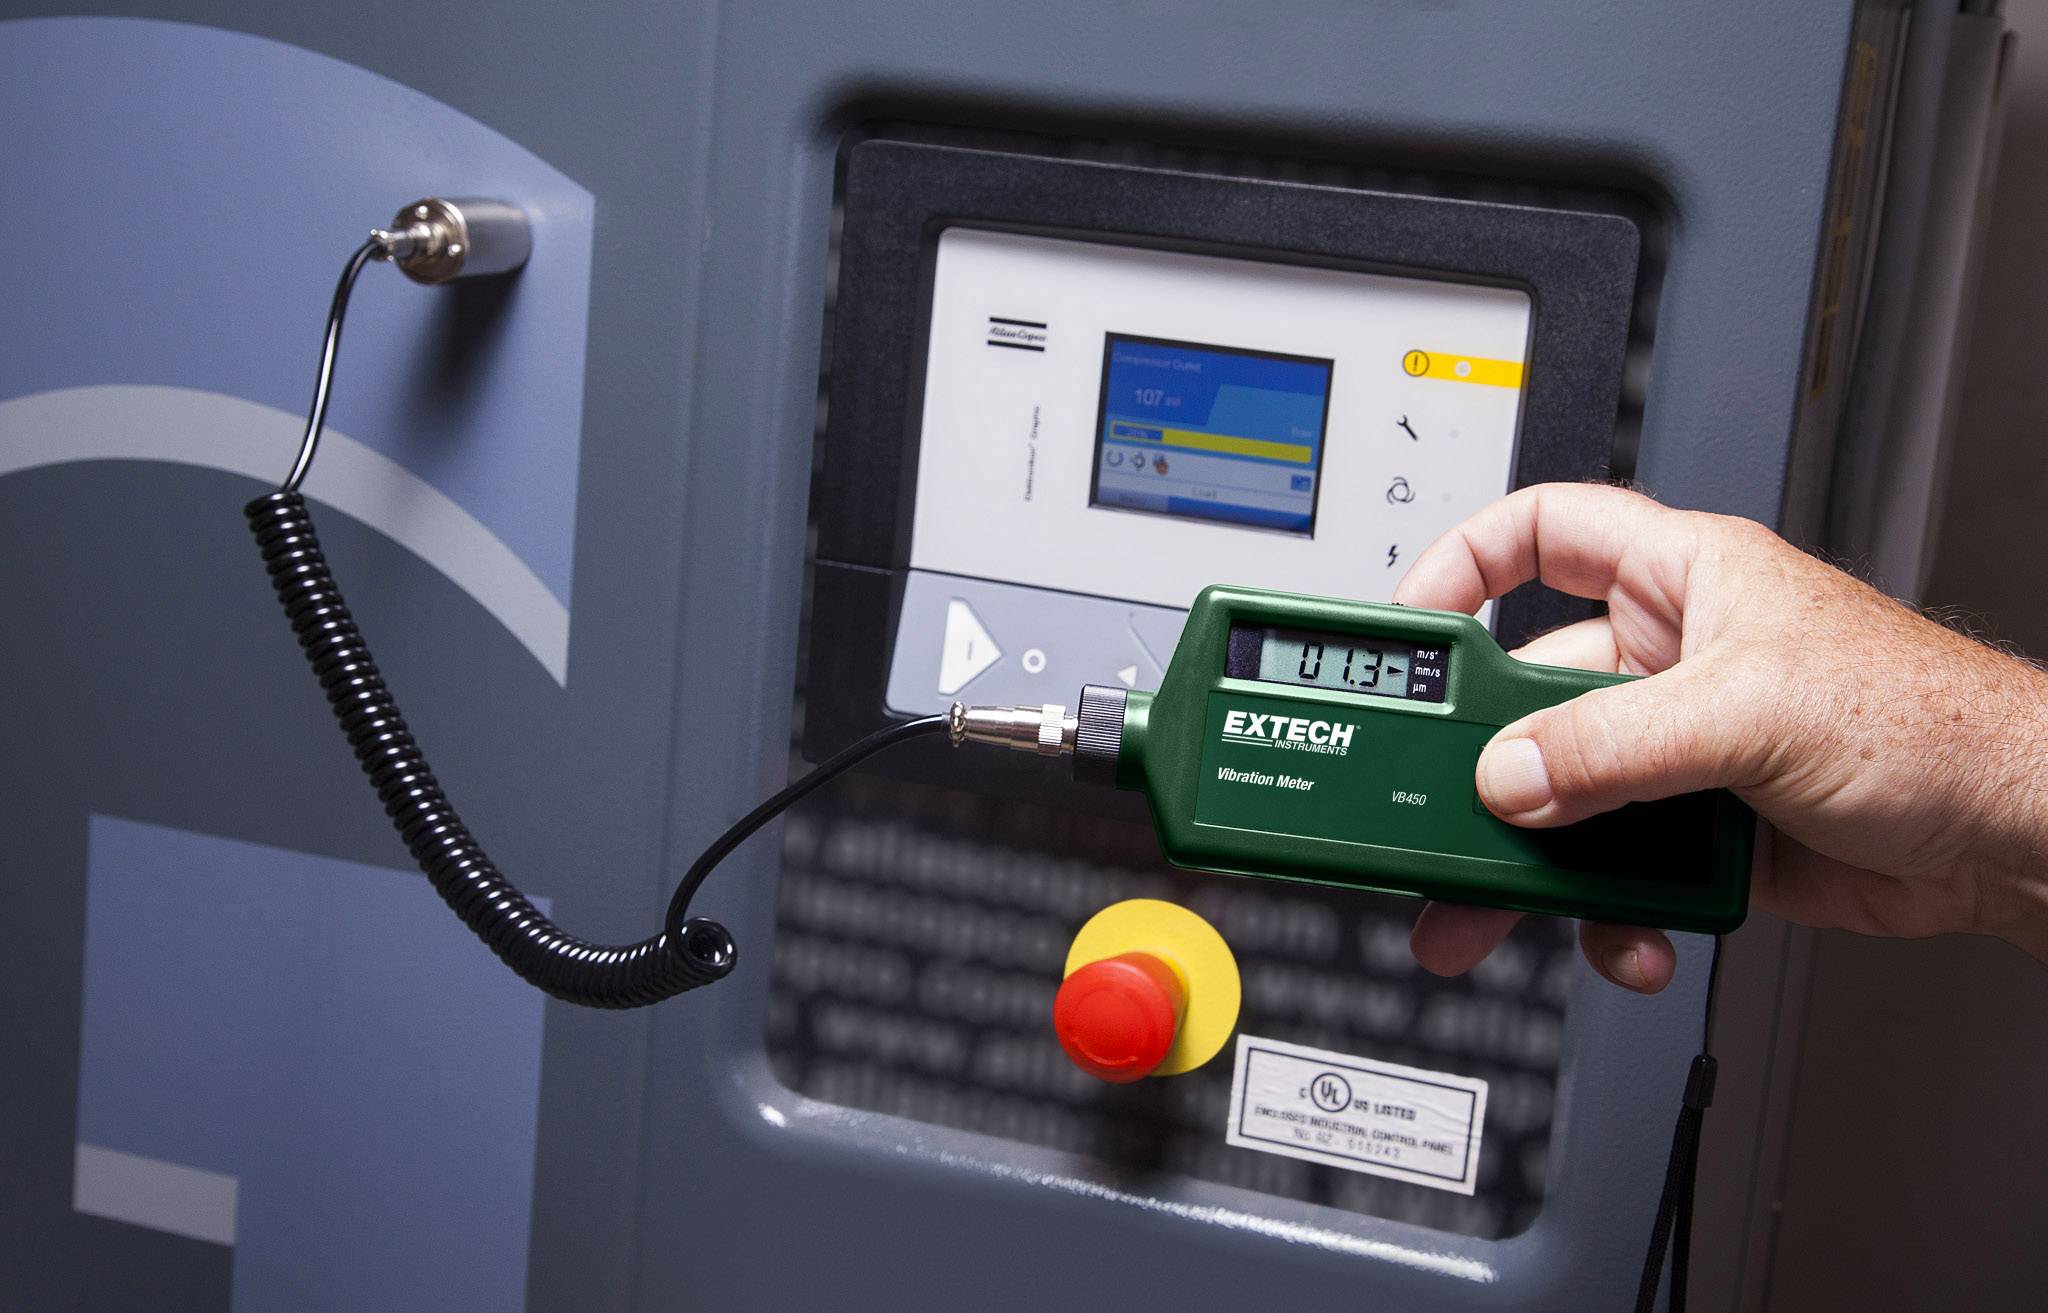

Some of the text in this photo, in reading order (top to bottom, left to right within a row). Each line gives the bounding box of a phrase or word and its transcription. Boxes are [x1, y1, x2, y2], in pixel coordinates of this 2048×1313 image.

[1135, 387, 1165, 406] 107
[1298, 640, 1384, 688] 01.3
[1415, 666, 1441, 678] mm/s
[1222, 710, 1355, 748] EXTECH
[1274, 739, 1348, 756] INSTRUMENTS
[1217, 767, 1315, 791] Vibration Meter
[1391, 790, 1427, 806] VB450
[1373, 1102, 1417, 1121] LISTED
